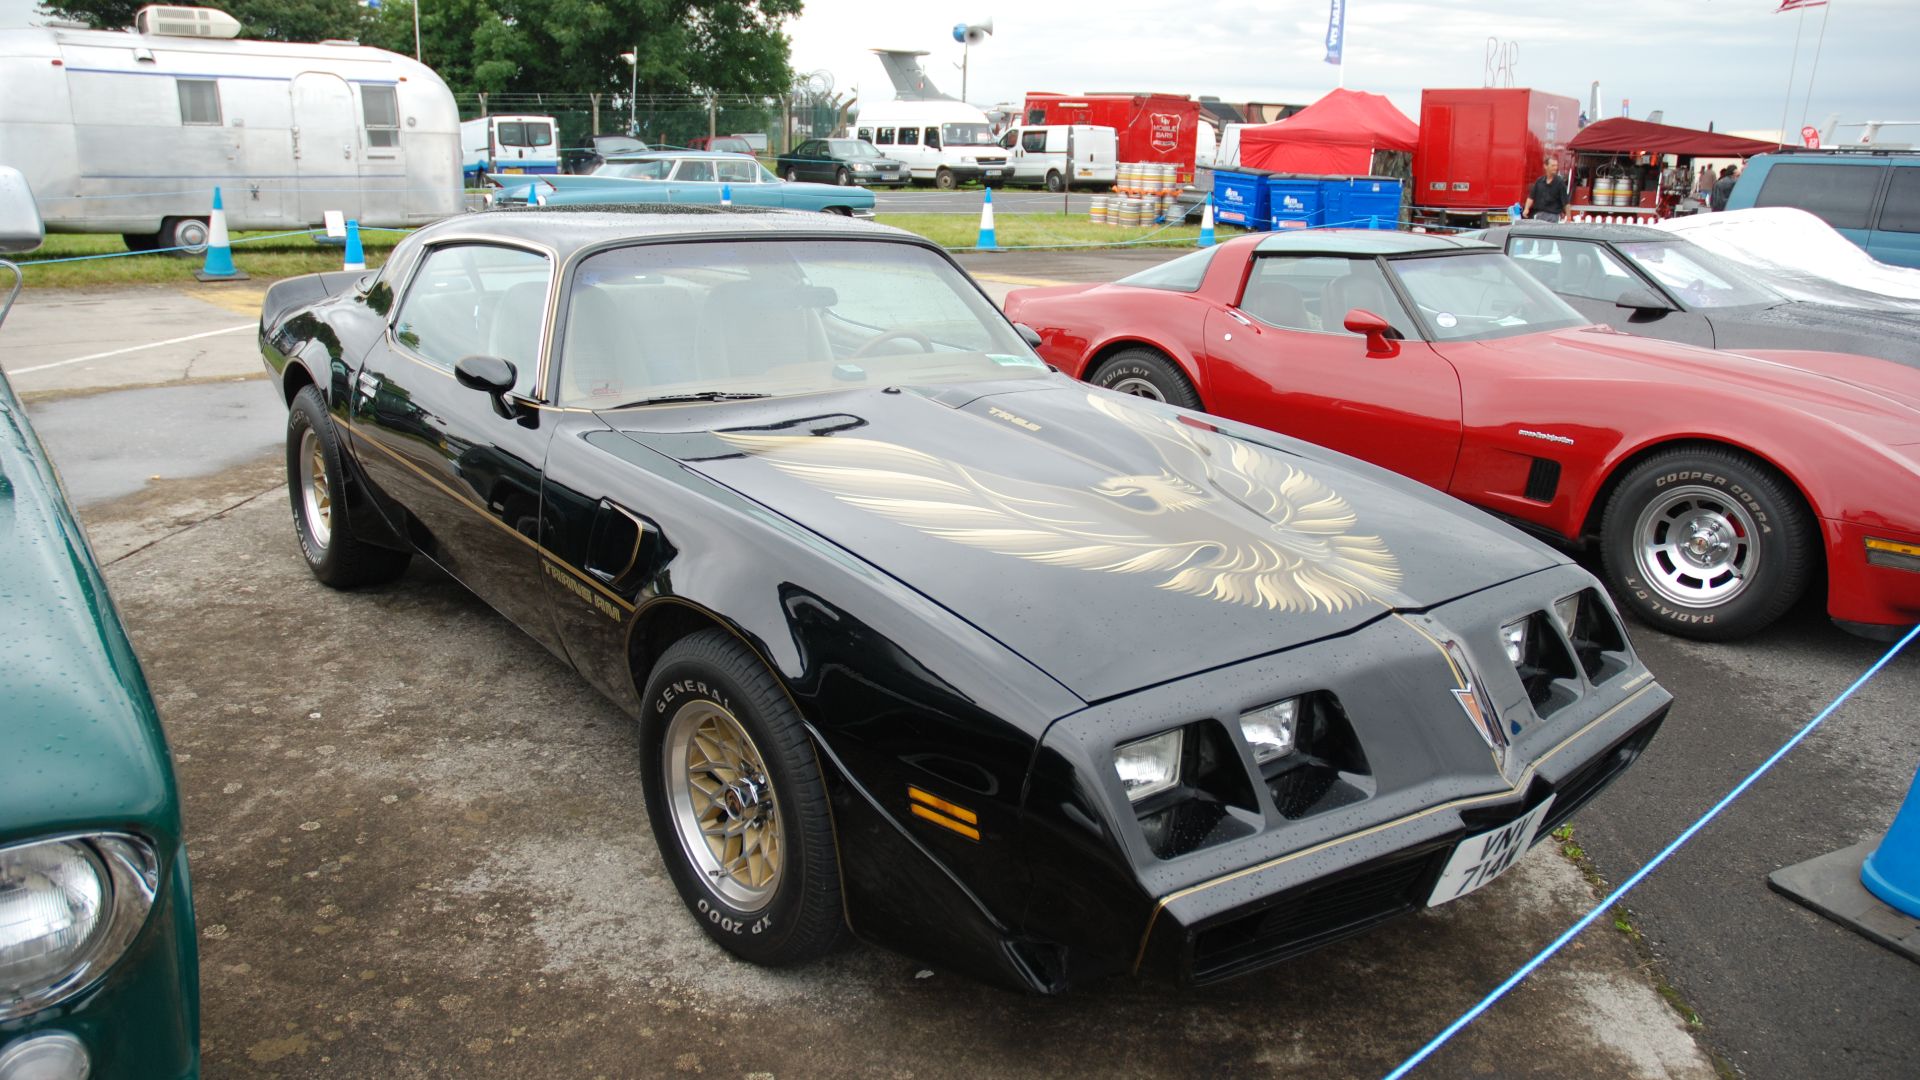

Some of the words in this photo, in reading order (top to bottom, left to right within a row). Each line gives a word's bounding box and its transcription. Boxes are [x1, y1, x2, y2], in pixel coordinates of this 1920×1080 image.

[1484, 36, 1519, 88] BAR
[1102, 367, 1129, 387] ADIAL
[1656, 471, 1727, 487] COOPER
[1730, 484, 1772, 534] COBRA
[542, 559, 592, 604] TRANS
[594, 594, 621, 623] AM
[1625, 575, 1649, 600] G/T
[1651, 599, 1715, 624] RADIAL
[656, 679, 735, 716] GENERAL
[1480, 811, 1536, 861] VNV
[697, 898, 743, 935] 2000
[752, 912, 772, 935] XP
